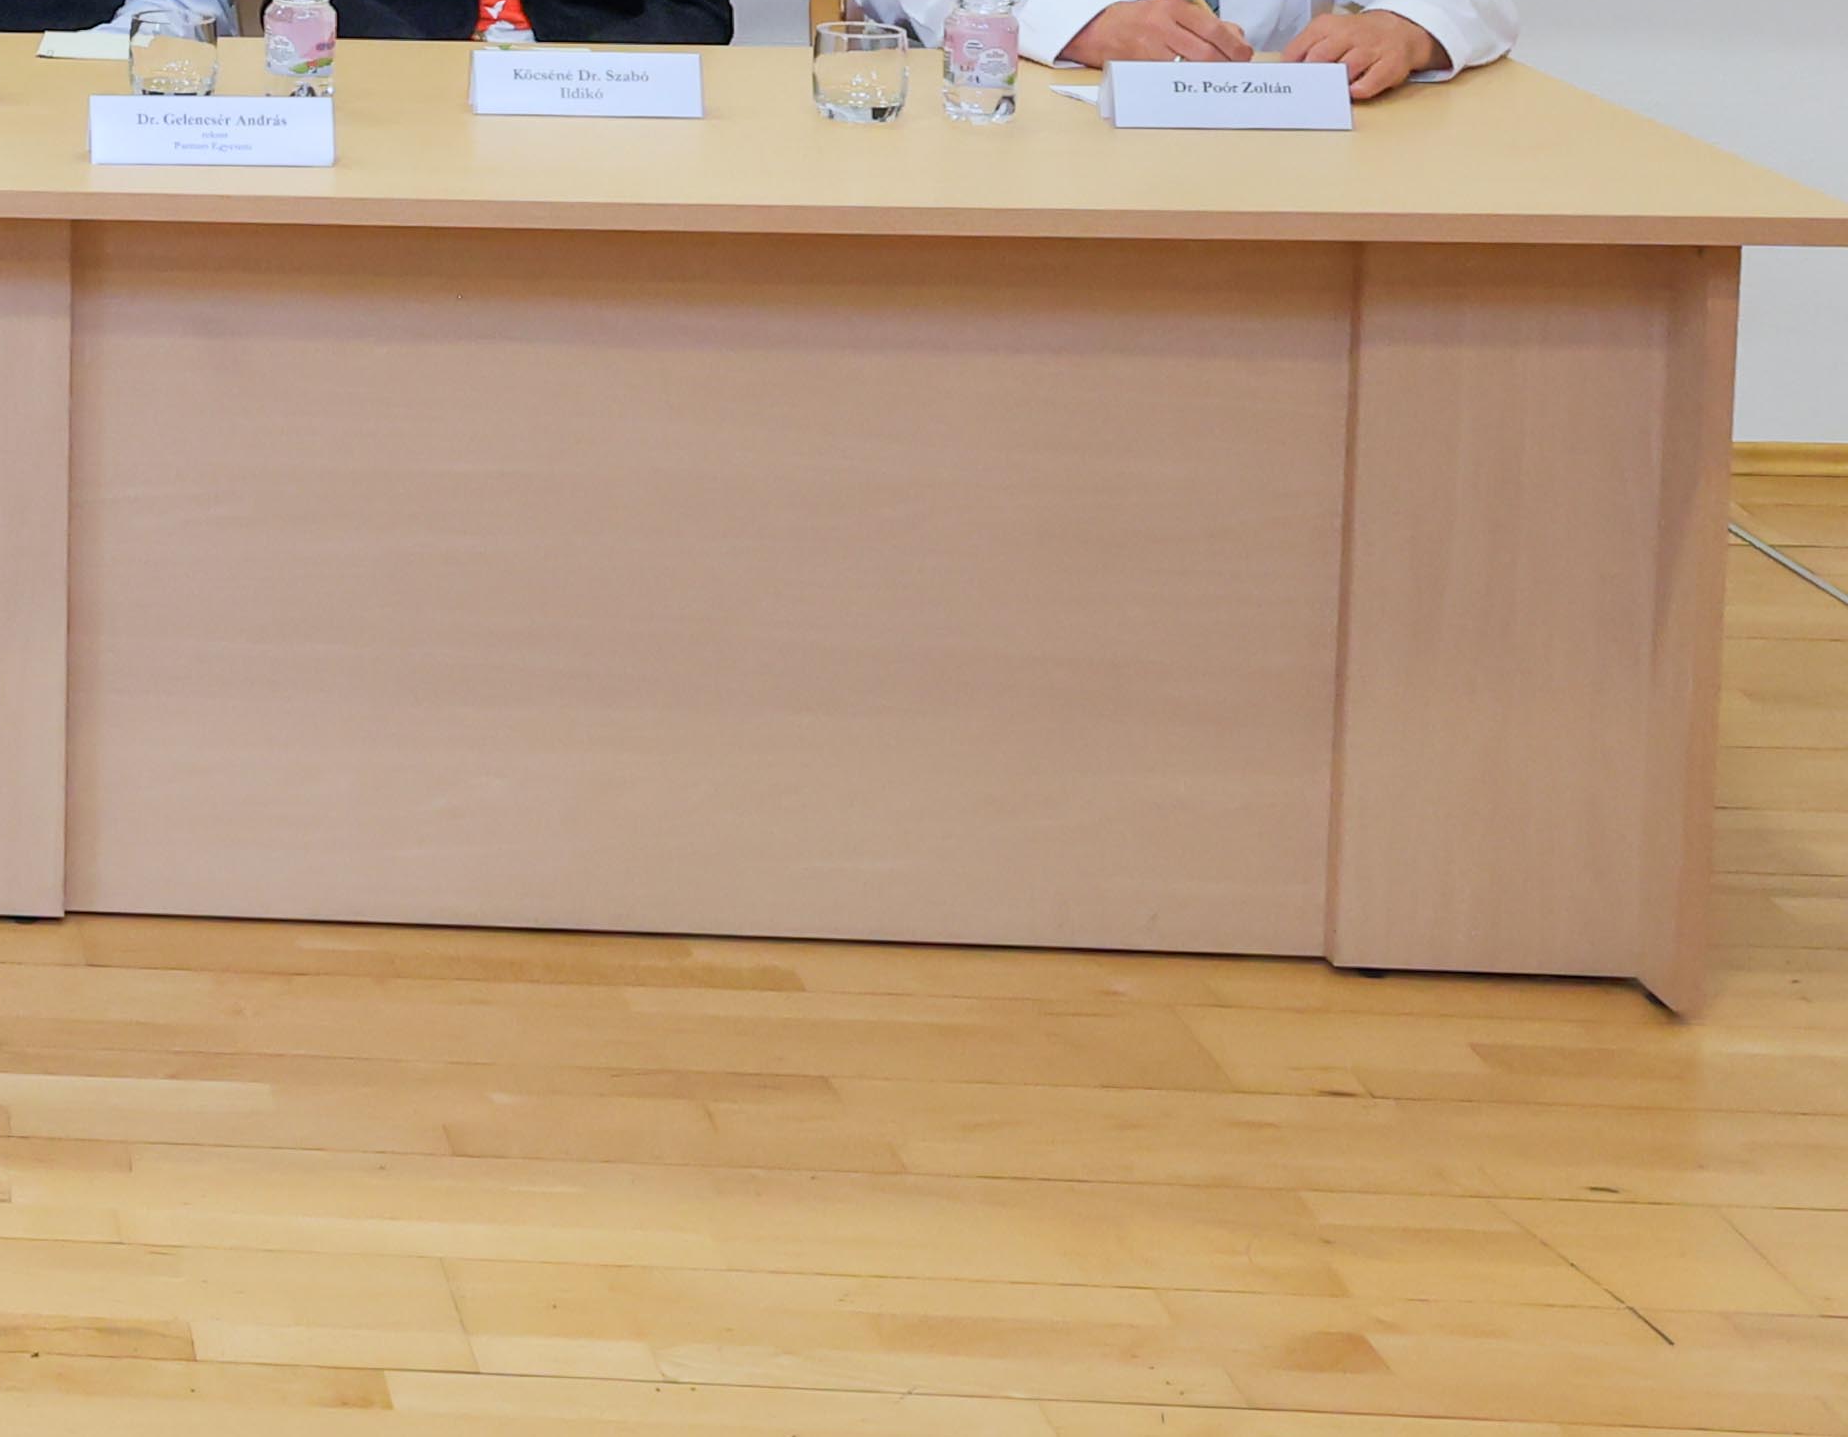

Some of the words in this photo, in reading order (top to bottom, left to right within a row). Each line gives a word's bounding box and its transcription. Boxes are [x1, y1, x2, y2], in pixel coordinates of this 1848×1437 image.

[578, 69, 601, 82] Dr.
[605, 69, 649, 82] Szabó
[560, 87, 604, 99] Ildikó
[1173, 81, 1197, 93] Dr.
[1202, 81, 1238, 93] Poór
[1242, 81, 1292, 94] Zoltán
[136, 113, 159, 125] Dr.
[163, 113, 231, 126] Gelencsér
[236, 114, 287, 126] András
